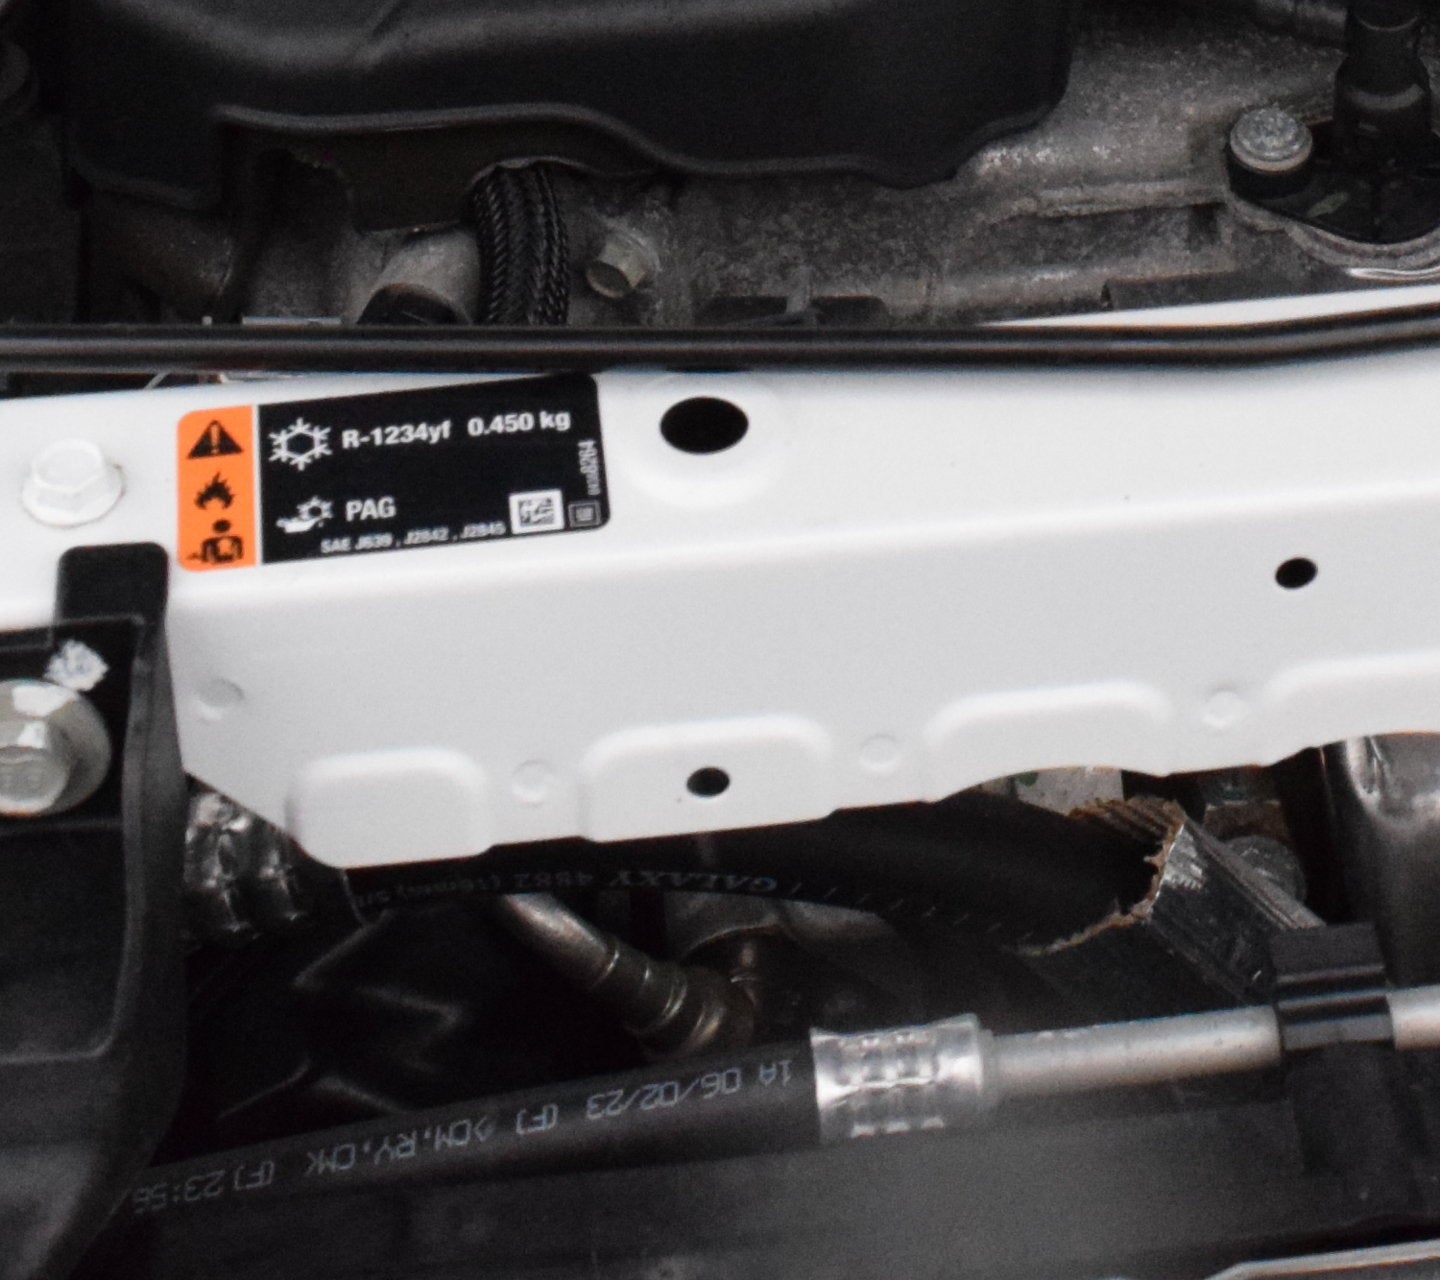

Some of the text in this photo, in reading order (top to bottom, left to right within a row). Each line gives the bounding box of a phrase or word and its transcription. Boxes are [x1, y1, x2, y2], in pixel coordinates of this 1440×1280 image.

[341, 409, 572, 449] R-1234yf 0.450 kg
[345, 497, 397, 522] PAG
[320, 536, 352, 554] SAE
